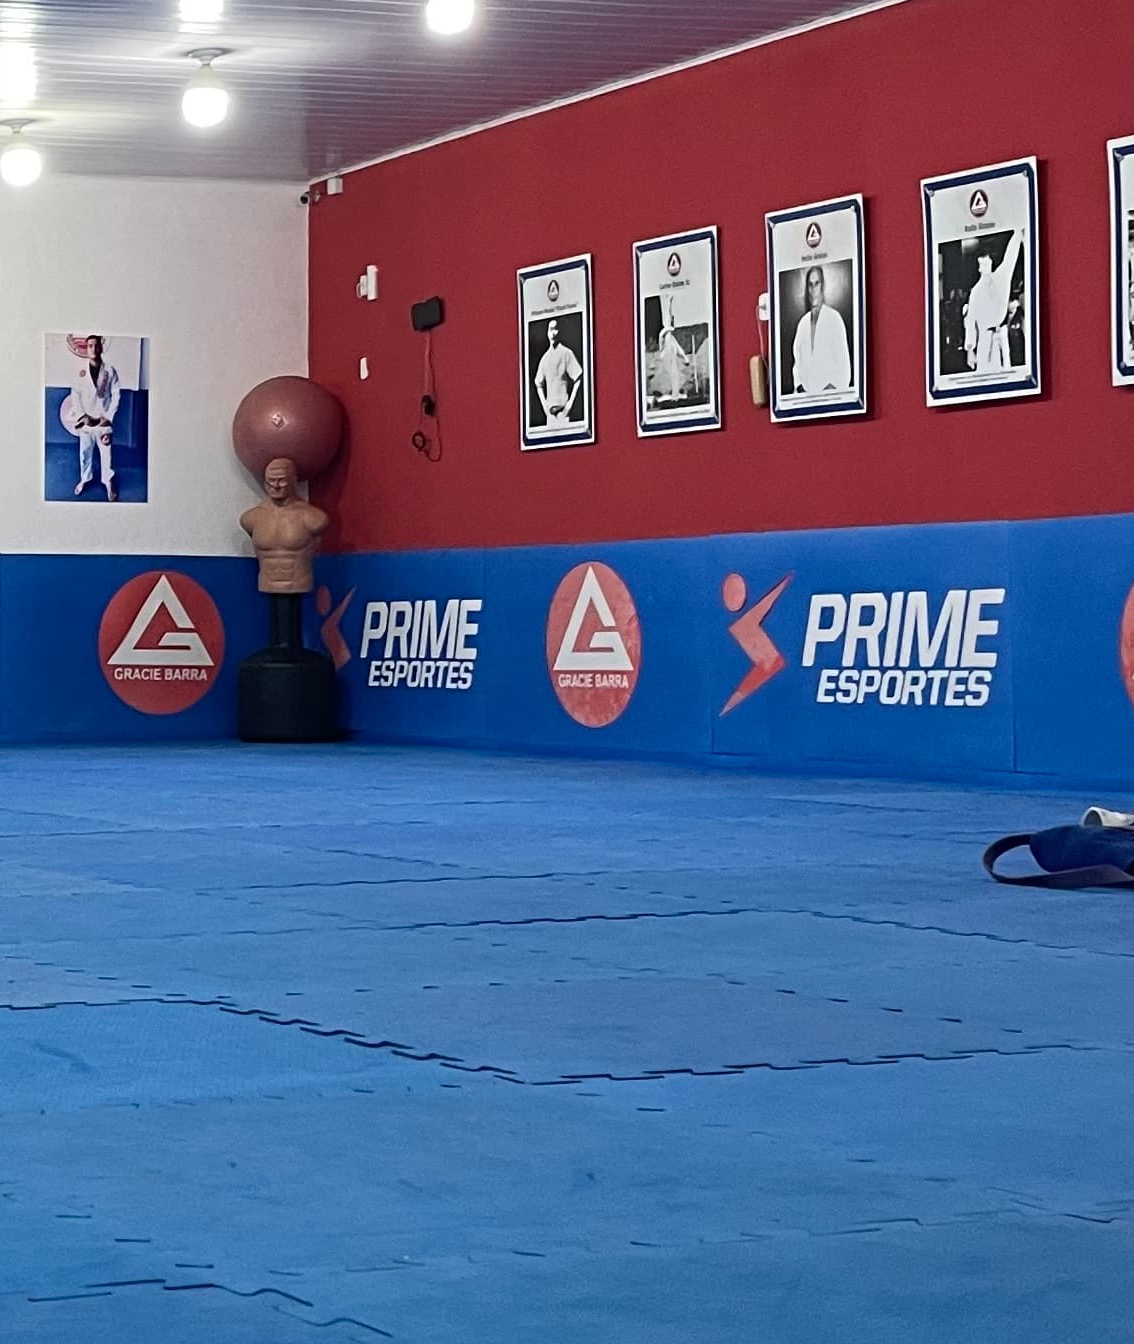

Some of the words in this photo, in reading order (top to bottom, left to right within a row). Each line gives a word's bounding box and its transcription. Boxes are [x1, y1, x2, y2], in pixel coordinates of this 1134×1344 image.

[360, 598, 483, 660] PRIME
[801, 588, 1006, 668] PRIME
[114, 667, 162, 681] GRACIE
[164, 668, 207, 681] BARRA
[368, 659, 474, 690] ESPORTES
[558, 673, 594, 688] GRACIE
[594, 673, 629, 689] BARRA
[816, 668, 995, 707] ESPORTES
